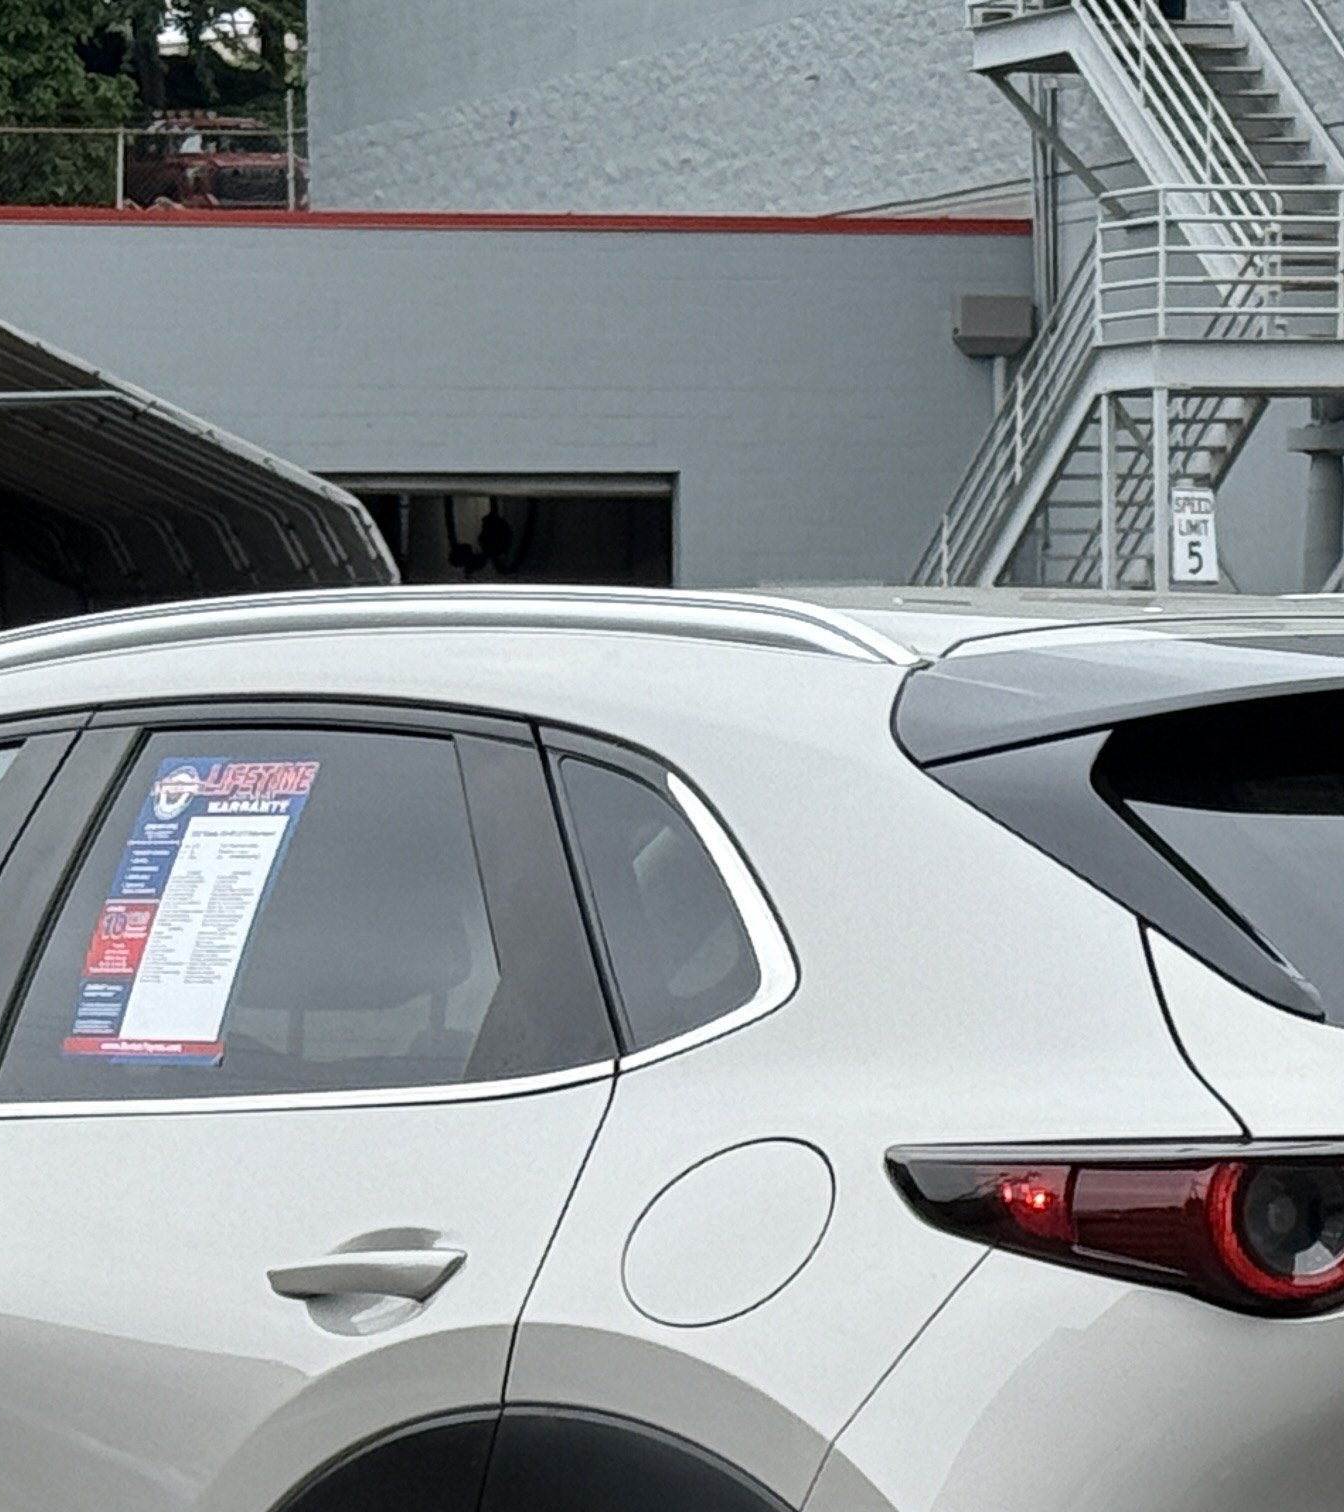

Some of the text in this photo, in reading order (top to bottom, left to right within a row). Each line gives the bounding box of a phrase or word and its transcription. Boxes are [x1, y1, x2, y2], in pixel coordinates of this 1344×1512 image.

[1174, 496, 1212, 514] SPEED
[1178, 519, 1209, 536] LIMIT
[1188, 540, 1204, 575] 5
[203, 762, 320, 796] LIFETIME
[207, 800, 291, 813] WARRANTY
